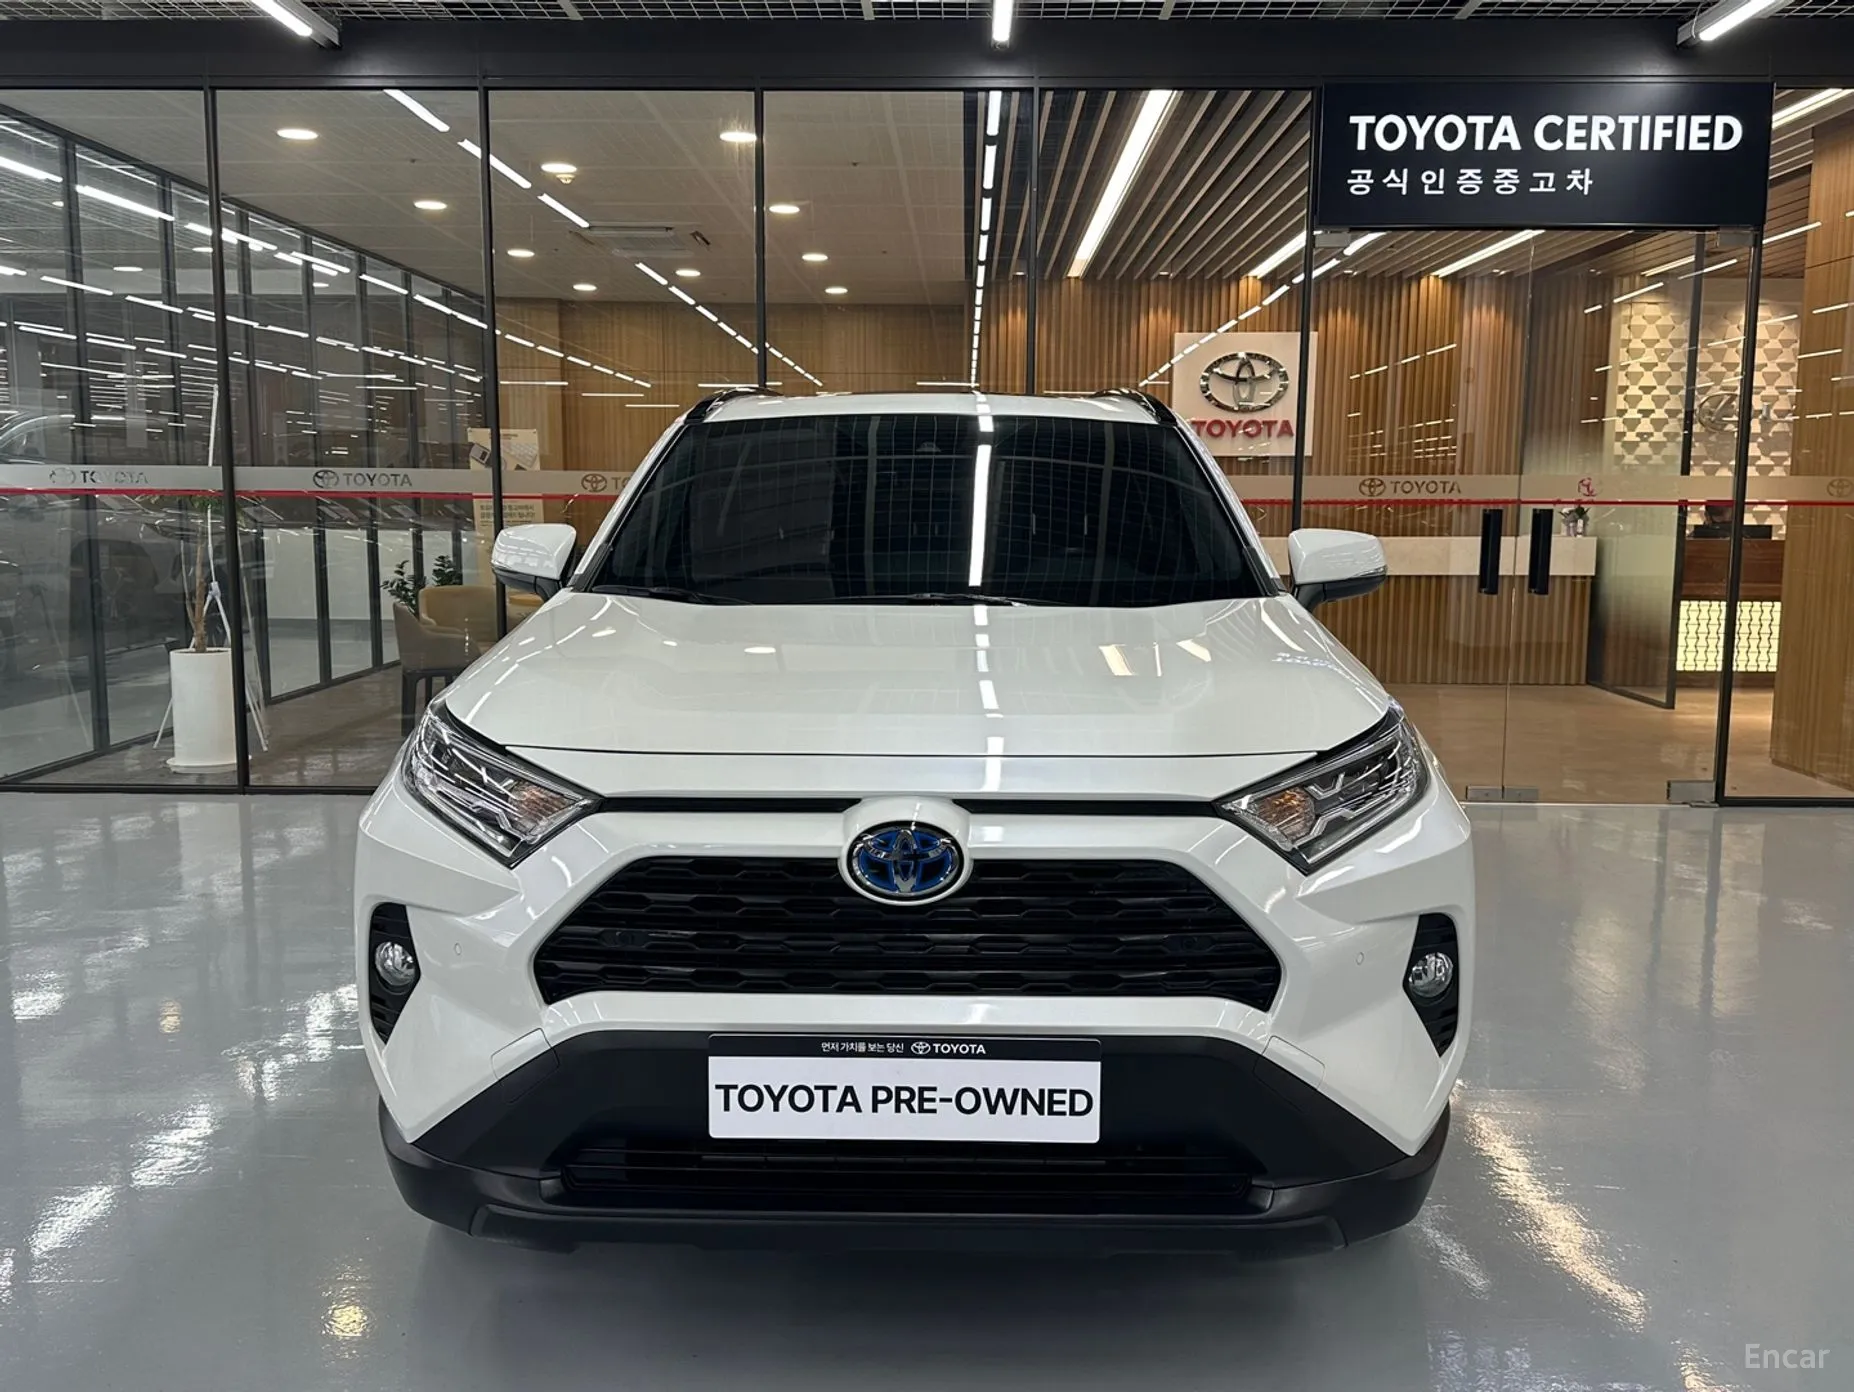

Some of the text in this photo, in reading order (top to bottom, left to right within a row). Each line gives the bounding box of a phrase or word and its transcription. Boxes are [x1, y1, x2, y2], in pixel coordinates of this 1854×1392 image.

[1349, 114, 1743, 152] TOYOTA CERTIFIED
[1346, 168, 1594, 195] 공식인증중고차
[1192, 419, 1294, 438] TOYOTA
[343, 473, 413, 487] TOYOTA
[1390, 480, 1462, 494] TOYOTA
[821, 1042, 839, 1053] 먼저
[840, 1042, 866, 1053] 가치를
[887, 1043, 904, 1054] 당신
[933, 1043, 986, 1055] TOYOTA
[715, 1084, 1094, 1117] TOYOTA PRE-OWNED
